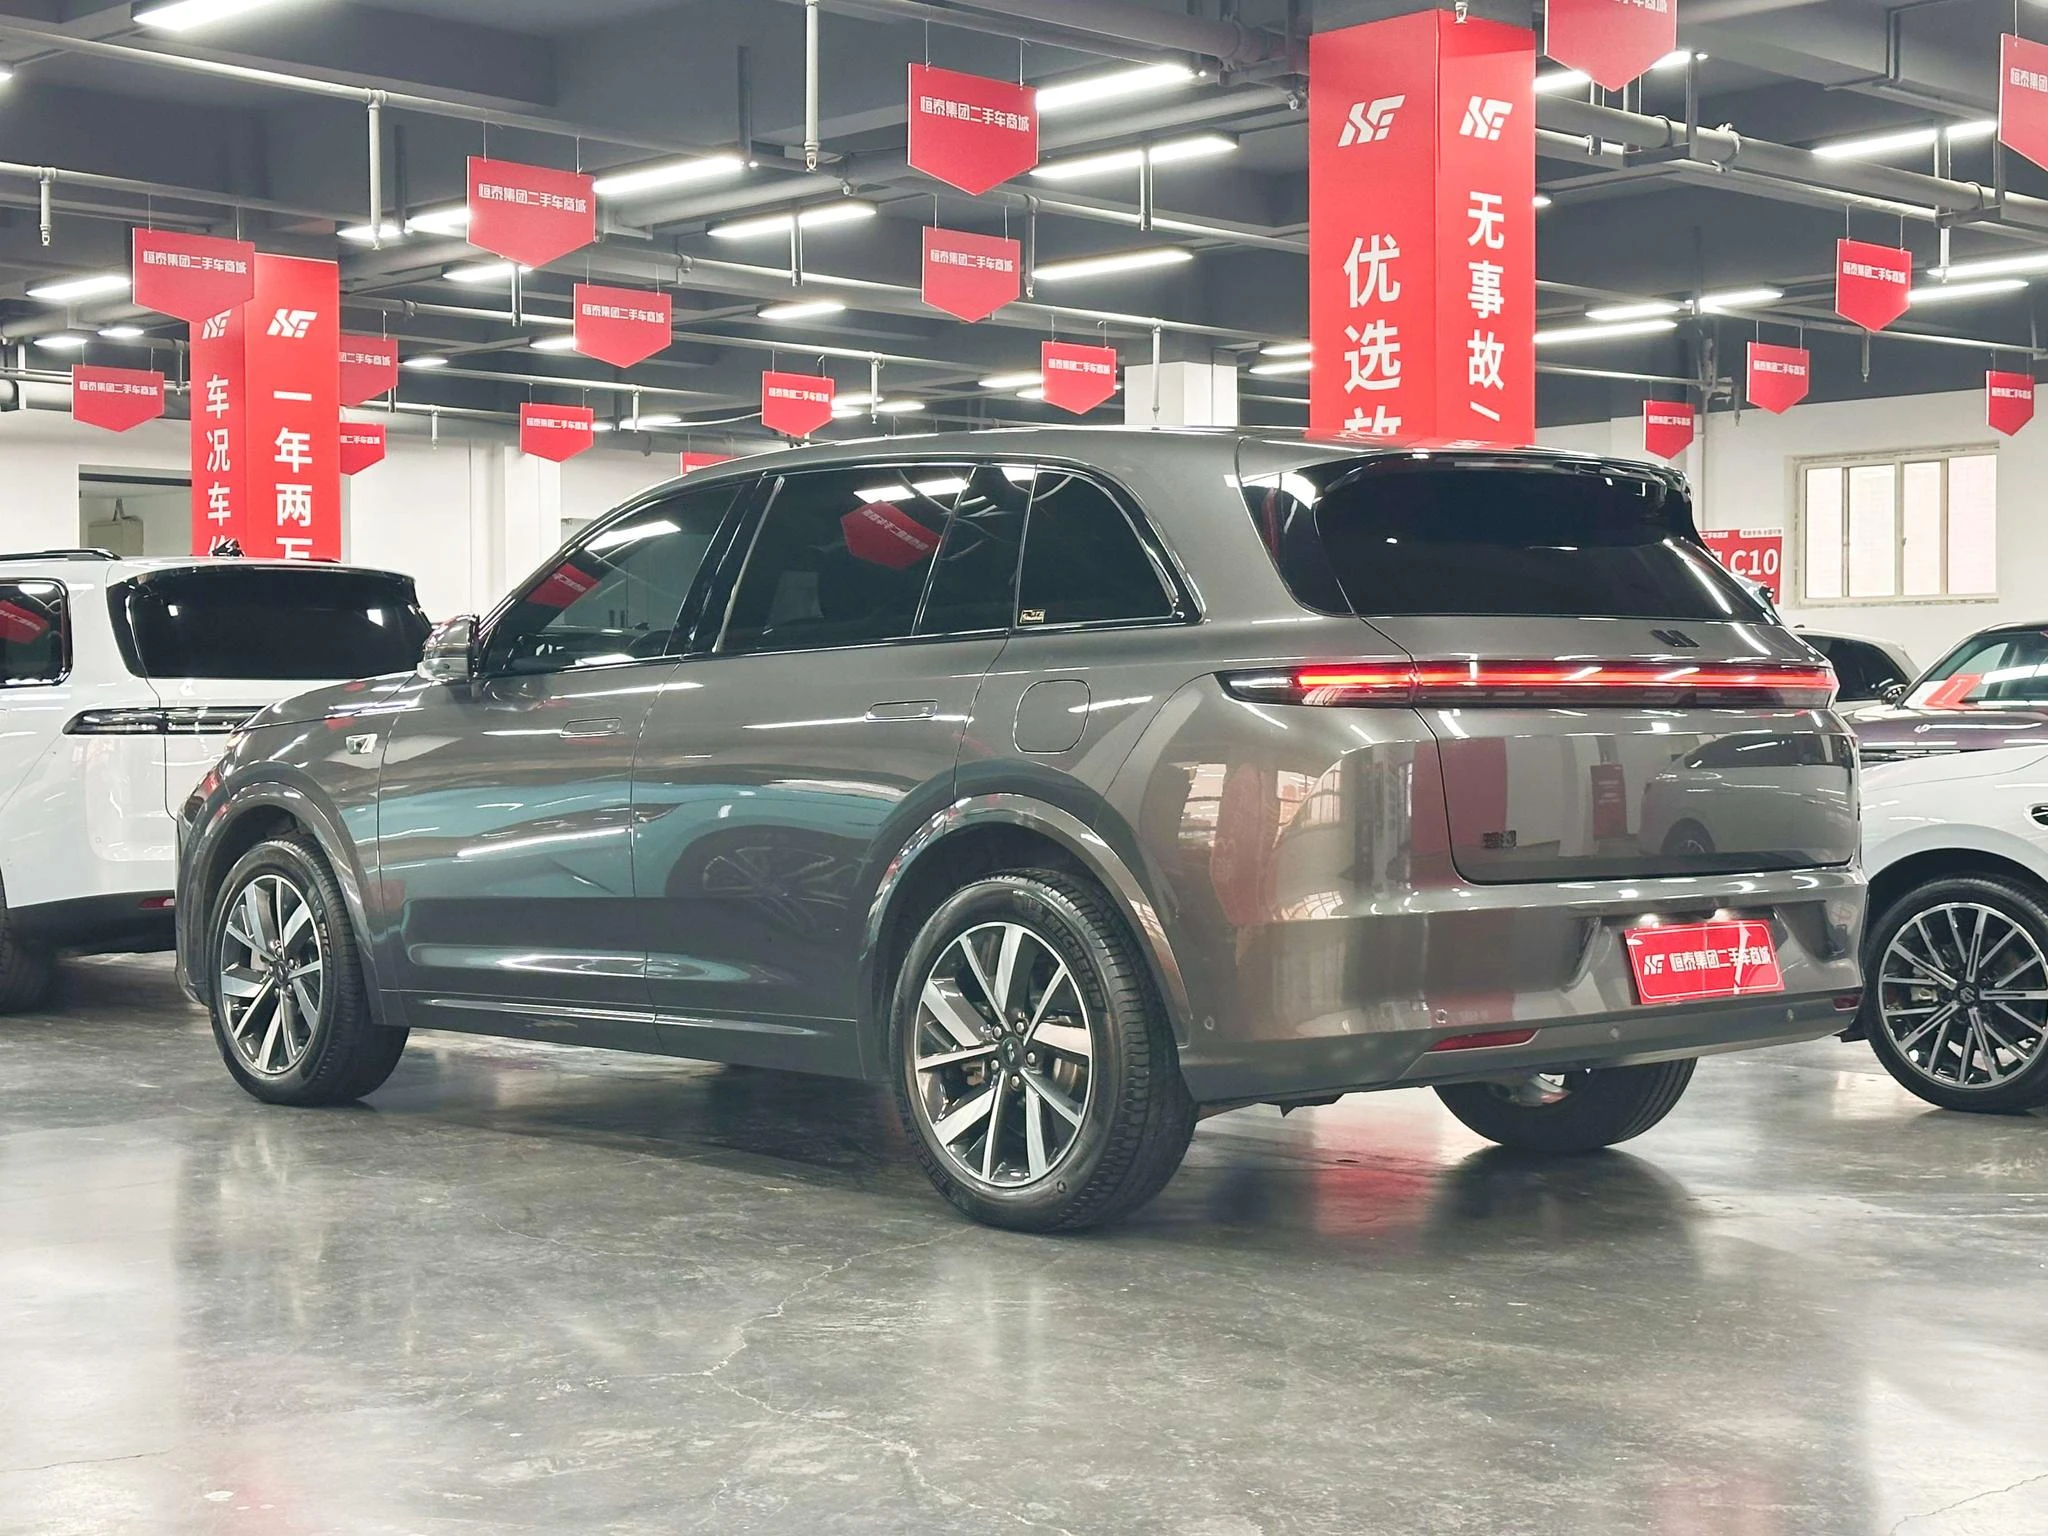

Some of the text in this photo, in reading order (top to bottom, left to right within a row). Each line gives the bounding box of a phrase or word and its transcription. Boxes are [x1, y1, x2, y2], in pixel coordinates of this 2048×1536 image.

[920, 96, 1030, 132] 恒泰集团二手车商城
[478, 183, 587, 213] 恒泰集团二手车商城
[143, 250, 247, 274] 恒泰集团二手车商城
[930, 249, 1013, 272] 恒泰集团二手车商城
[582, 303, 665, 323] 恒泰集团二手车商城
[1730, 548, 1779, 575] C10
[1669, 945, 1773, 973] 恒泰集团二手车商城
